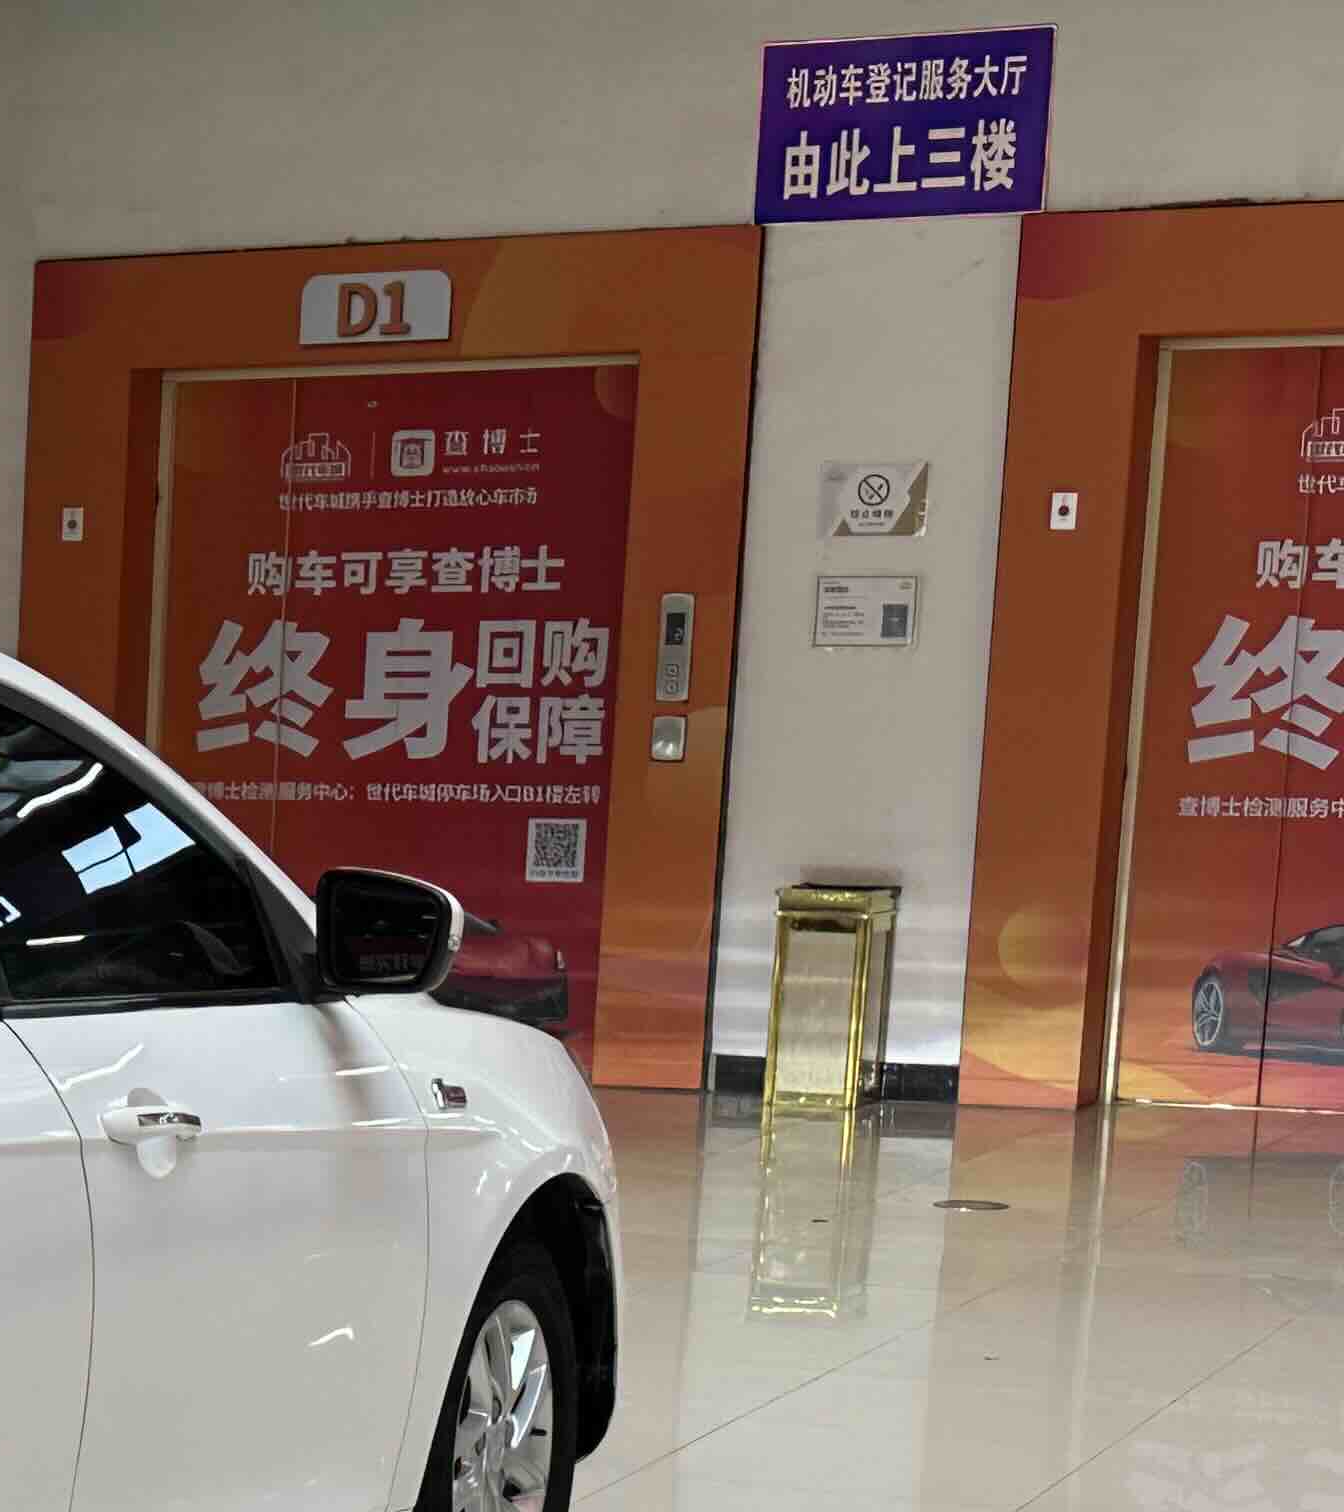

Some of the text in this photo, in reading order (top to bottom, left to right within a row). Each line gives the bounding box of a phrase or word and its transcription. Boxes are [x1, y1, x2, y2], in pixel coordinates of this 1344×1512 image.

[786, 54, 1028, 109] 机动车登记服务大厅
[782, 118, 1018, 201] 由此上三楼
[336, 281, 411, 336] D1
[443, 428, 542, 456] 查博士
[246, 544, 566, 598] 购车可享查博士
[475, 618, 610, 692] 回购
[196, 616, 475, 762] 终身
[472, 692, 605, 766] 保障
